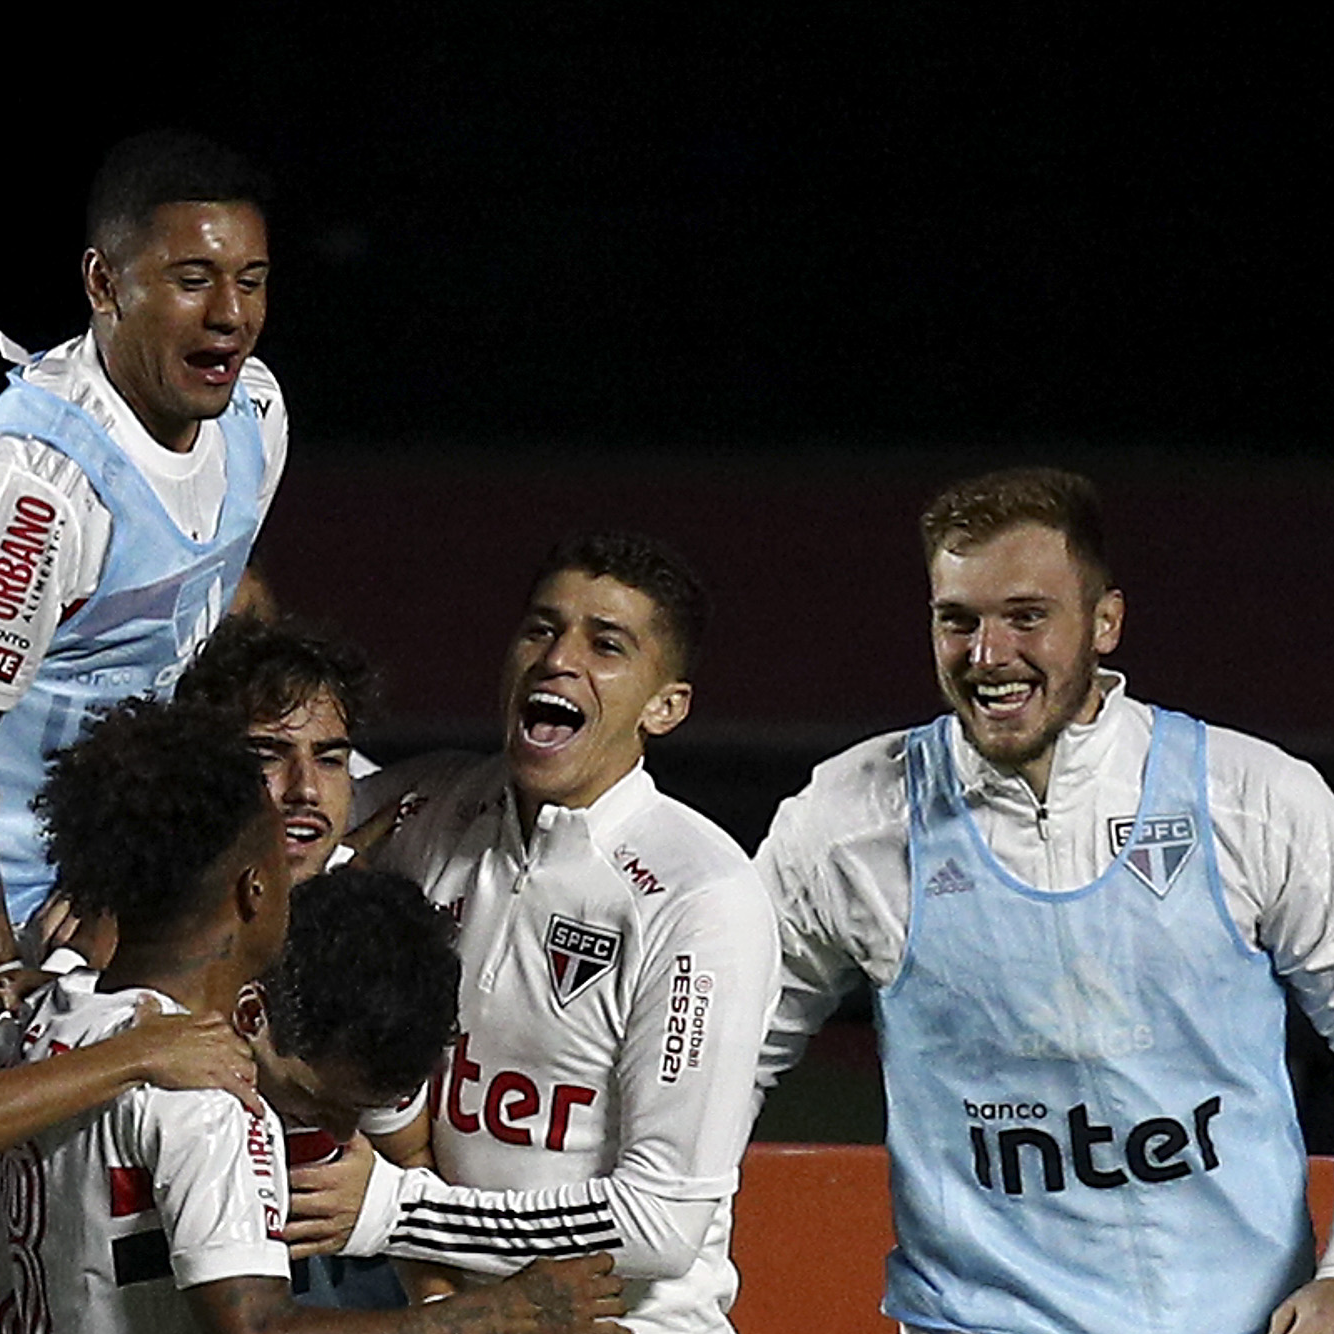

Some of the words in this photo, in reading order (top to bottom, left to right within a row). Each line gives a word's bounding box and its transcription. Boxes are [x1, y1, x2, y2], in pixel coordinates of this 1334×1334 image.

[1118, 823, 1190, 843] SPFC
[554, 926, 610, 957] SPFC
[661, 954, 691, 1083] PES2021
[428, 1032, 598, 1151] ter
[963, 1098, 1048, 1120] banco
[969, 1094, 1221, 1196] inter
